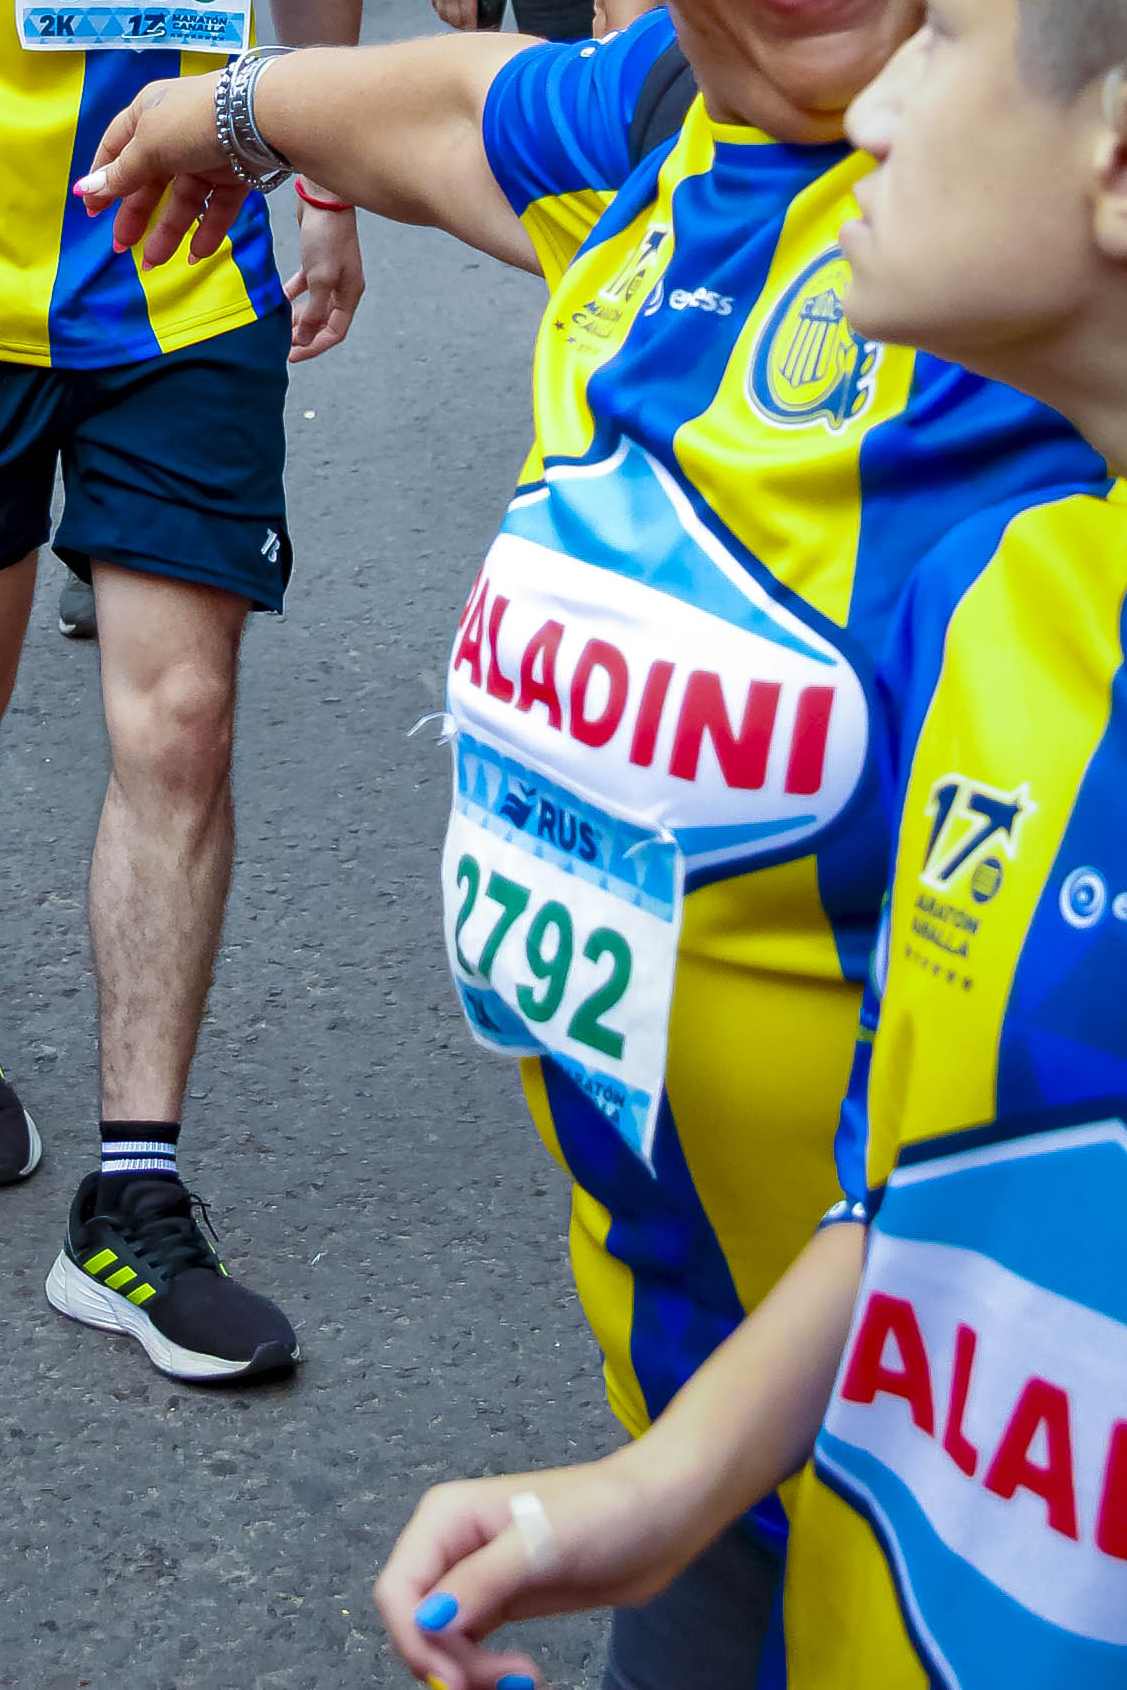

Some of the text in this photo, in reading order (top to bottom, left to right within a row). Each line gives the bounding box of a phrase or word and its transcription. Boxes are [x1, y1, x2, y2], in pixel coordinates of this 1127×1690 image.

[39, 14, 75, 37] 2K
[537, 797, 598, 863] RUS
[455, 853, 633, 1061] 2792
